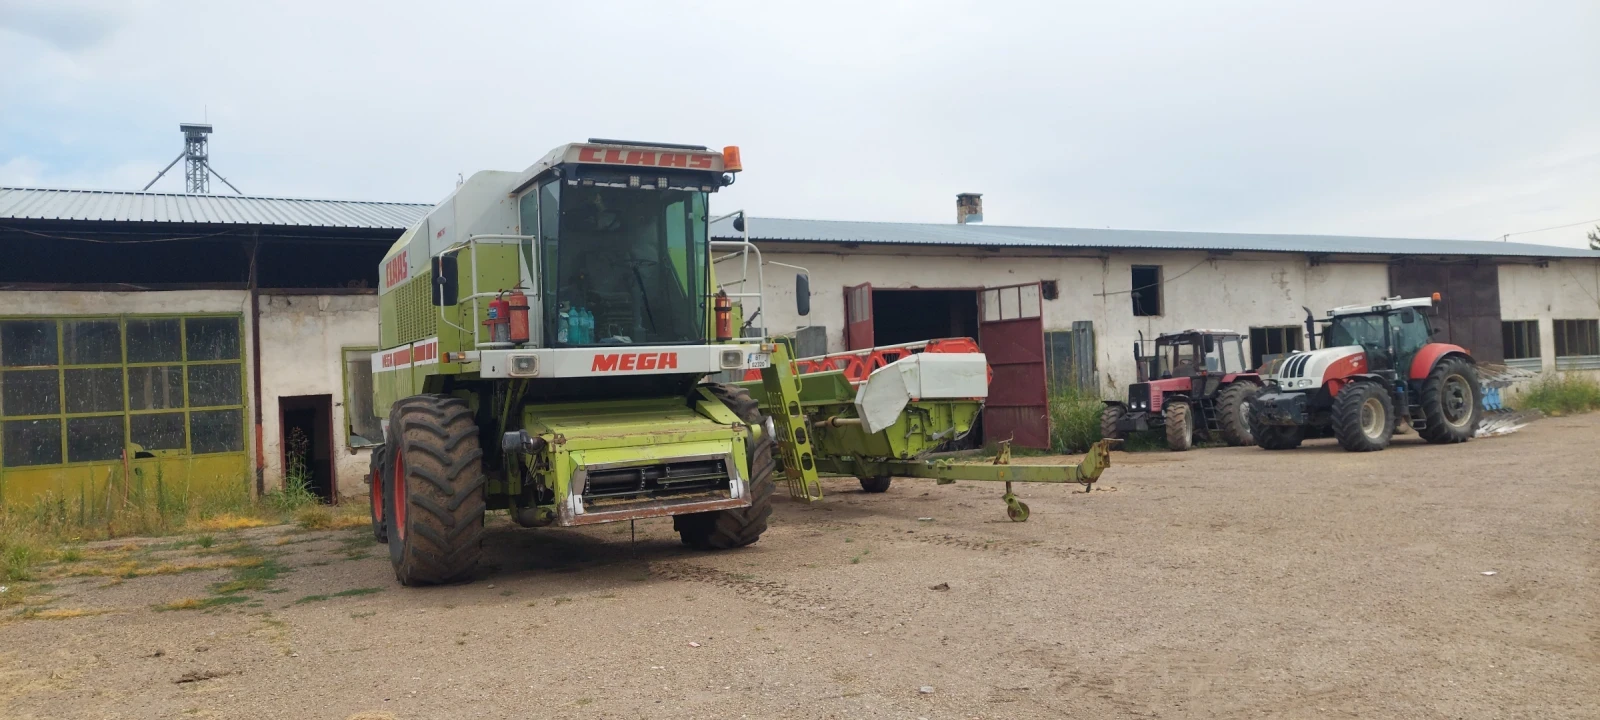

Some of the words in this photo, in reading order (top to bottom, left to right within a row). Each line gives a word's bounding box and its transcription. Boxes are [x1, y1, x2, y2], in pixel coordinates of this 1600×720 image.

[578, 147, 712, 169] CLAAS
[386, 250, 408, 288] CLAAS
[591, 352, 678, 372] MEGA
